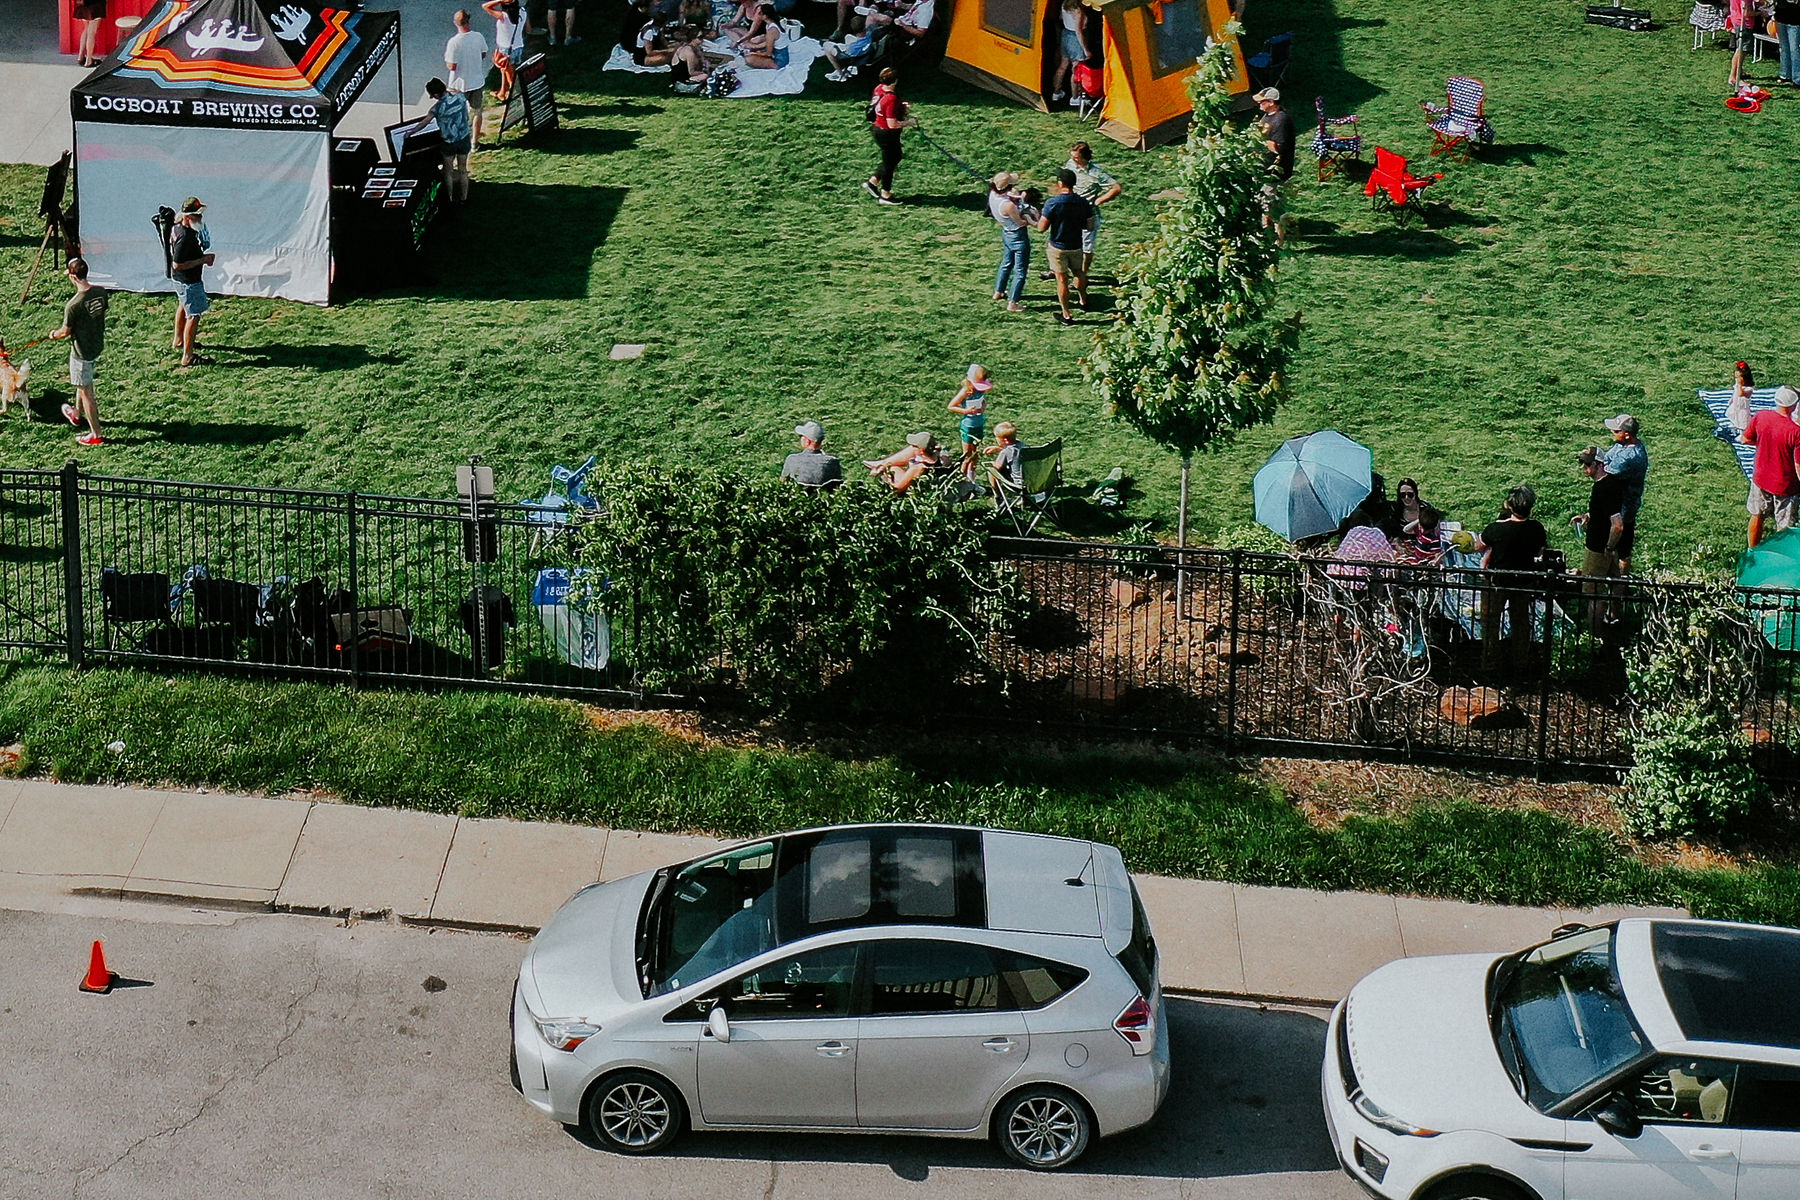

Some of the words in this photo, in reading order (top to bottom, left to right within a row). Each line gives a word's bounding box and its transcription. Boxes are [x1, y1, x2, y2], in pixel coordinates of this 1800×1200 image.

[84, 95, 183, 115] LOGBOAT
[192, 101, 283, 118] BREWING
[289, 104, 320, 119] CO.
